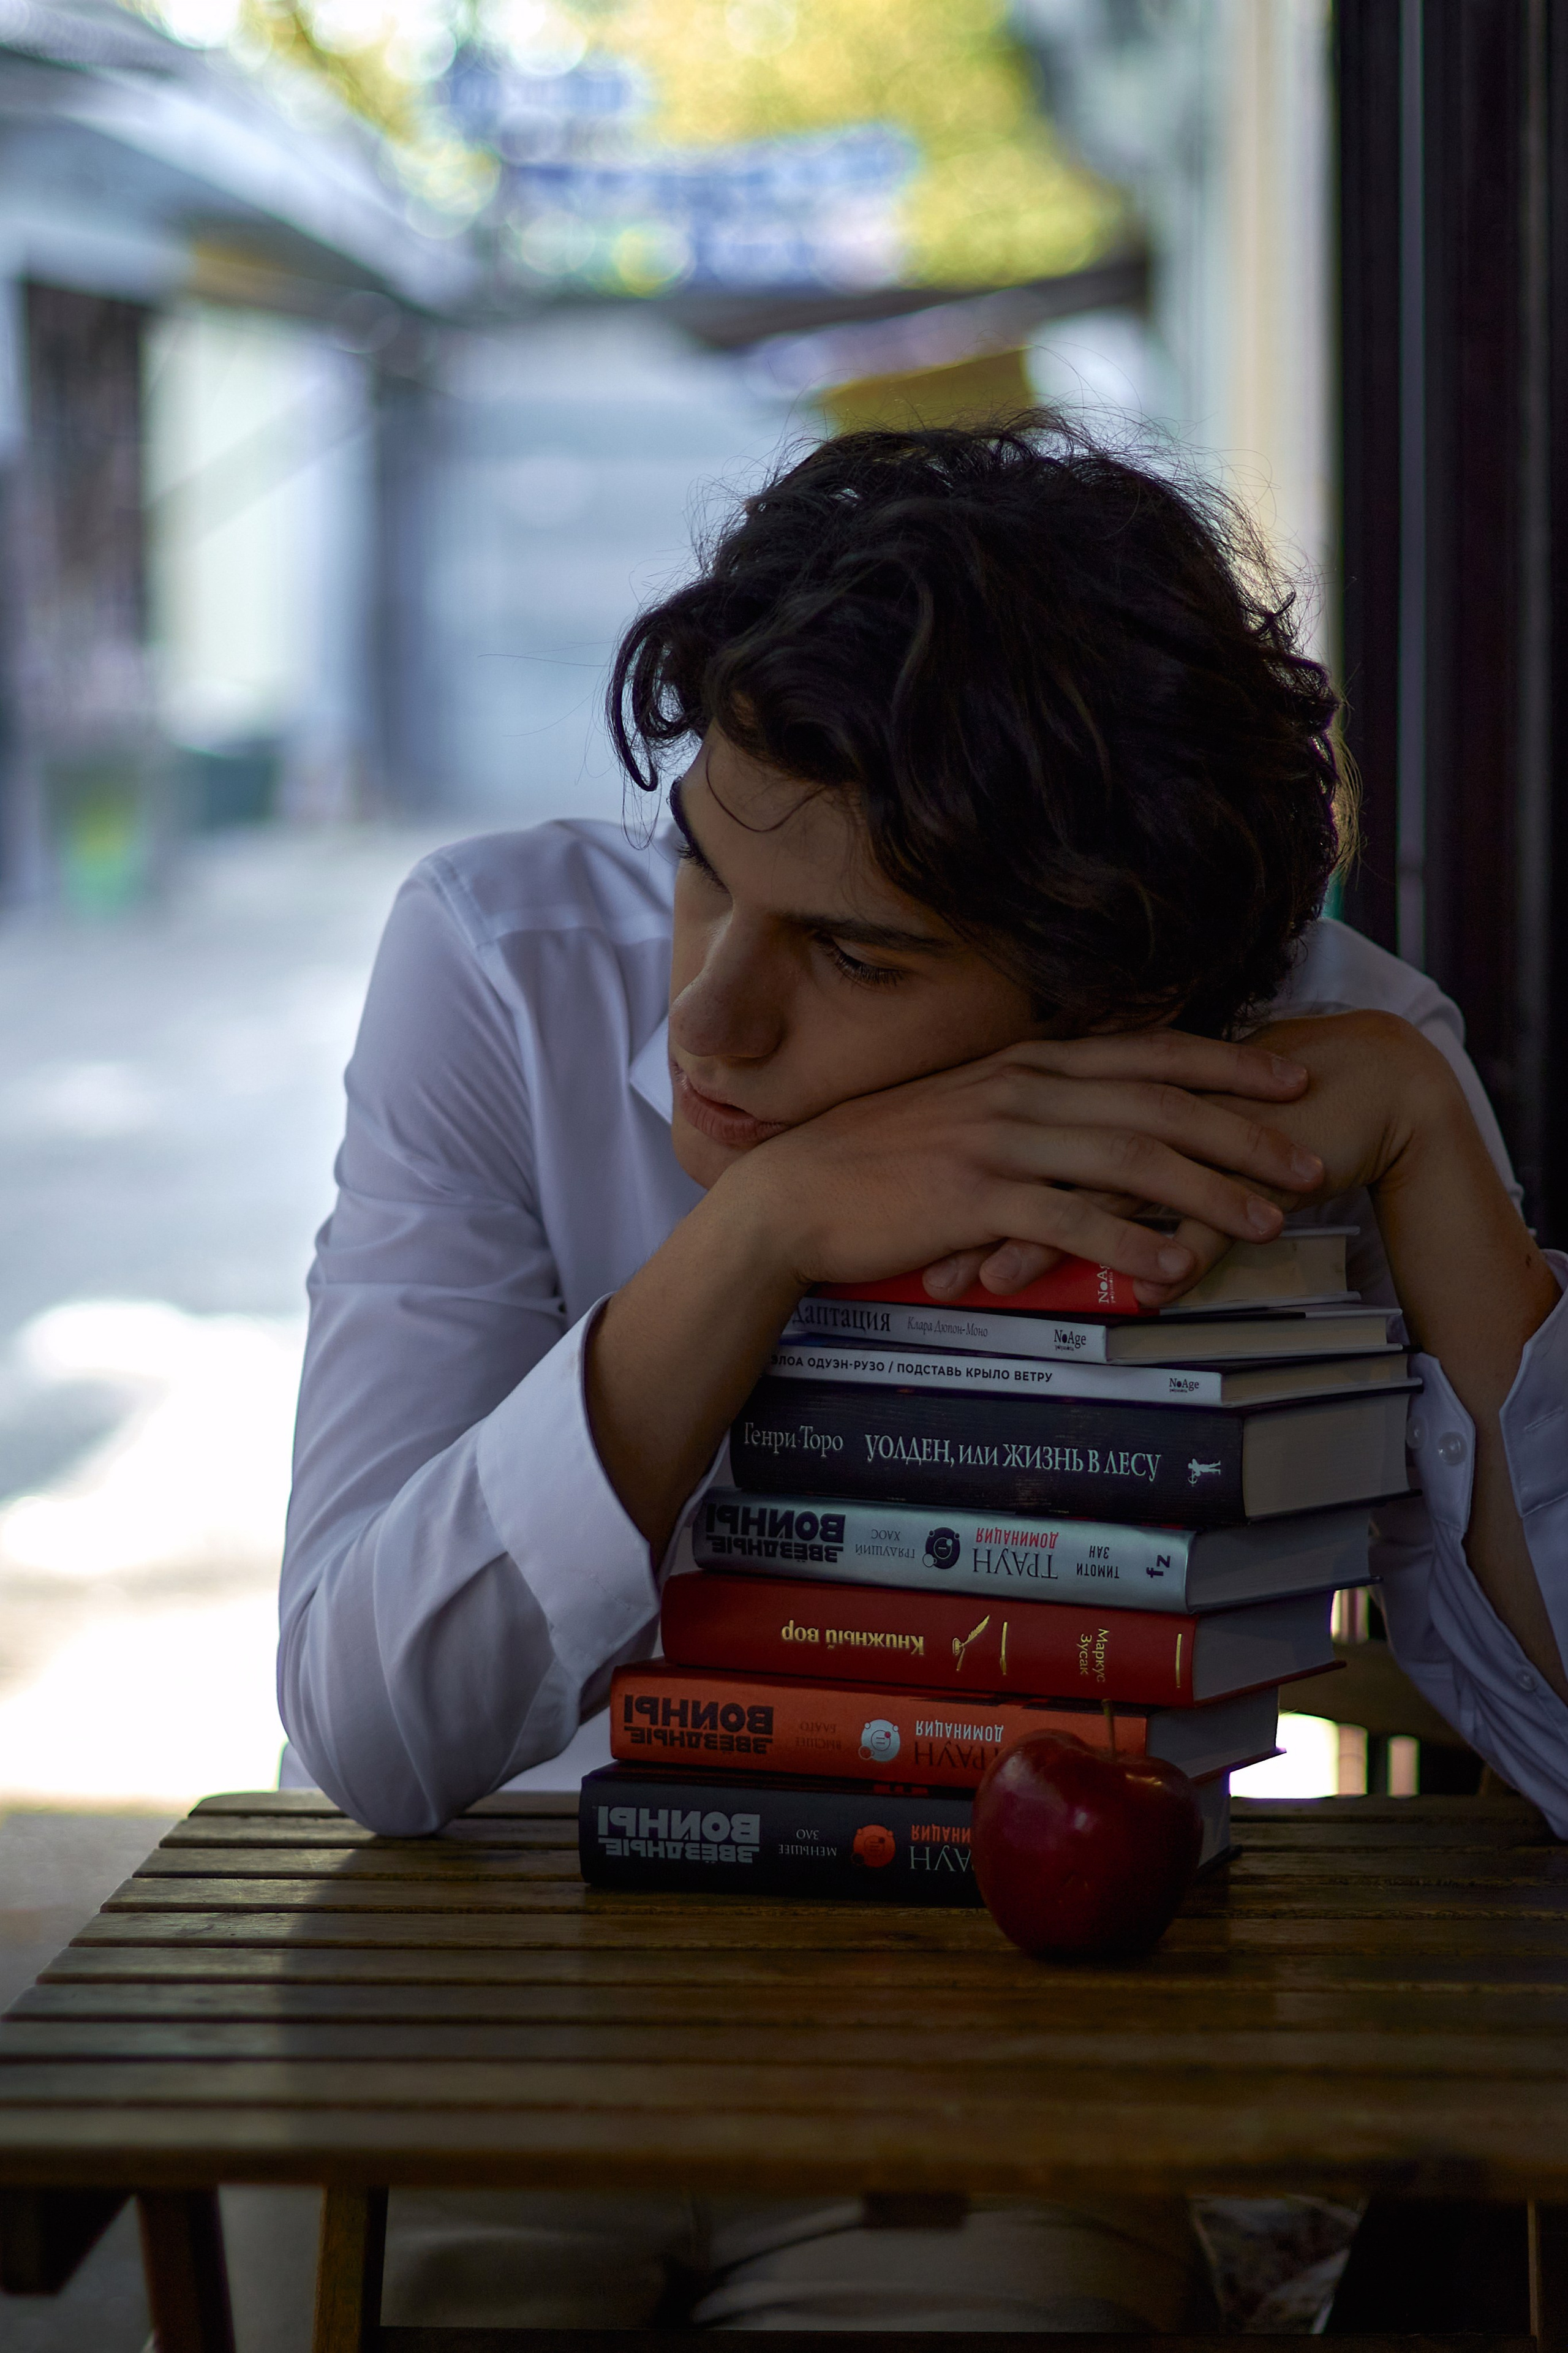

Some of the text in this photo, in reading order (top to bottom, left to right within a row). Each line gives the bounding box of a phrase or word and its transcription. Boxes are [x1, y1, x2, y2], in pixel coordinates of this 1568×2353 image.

[1096, 1264, 1109, 1304] NoA
[793, 1304, 891, 1332] даптация
[907, 1316, 988, 1337] Клара Дюпон-Моно
[1054, 1329, 1086, 1349] NoAge
[771, 1354, 803, 1366] ЭЛОА
[808, 1356, 884, 1372] ОДУЭН-РУЗО
[897, 1363, 961, 1377] ПОДСТАВЬ
[966, 1367, 1010, 1380] КРЫЛО
[1014, 1370, 1052, 1382] ВЕТРУ
[1169, 1378, 1199, 1391] NoAge
[743, 1422, 844, 1457] Генри Торо
[864, 1433, 954, 1468] УОЛДЕН,
[1001, 1443, 1084, 1472] ЖИЗНЬ
[1087, 1449, 1101, 1474] В
[1104, 1450, 1162, 1482] ЛЕСУ
[871, 1529, 901, 1541] ХАОС
[976, 1527, 1059, 1549] ДОМИНАЦИЯ
[855, 1544, 916, 1558] ГРЯДУЩИЙ
[1089, 1545, 1110, 1558] ЗАН
[972, 1547, 1058, 1579] ТРАУН
[1077, 1563, 1120, 1579] ТИМОТИ
[781, 1619, 924, 1655] Книжный вор
[1076, 1633, 1093, 1676] Зусак
[1091, 1628, 1110, 1683] Маркус
[916, 1720, 1005, 1743] ДОМИНАЦИЯ
[796, 1829, 820, 1840] ЗЛО
[911, 1823, 971, 1844] ИНАЦИЯ
[778, 1843, 837, 1857] МЕНЬШЕЕ
[909, 1844, 974, 1873] АУН
